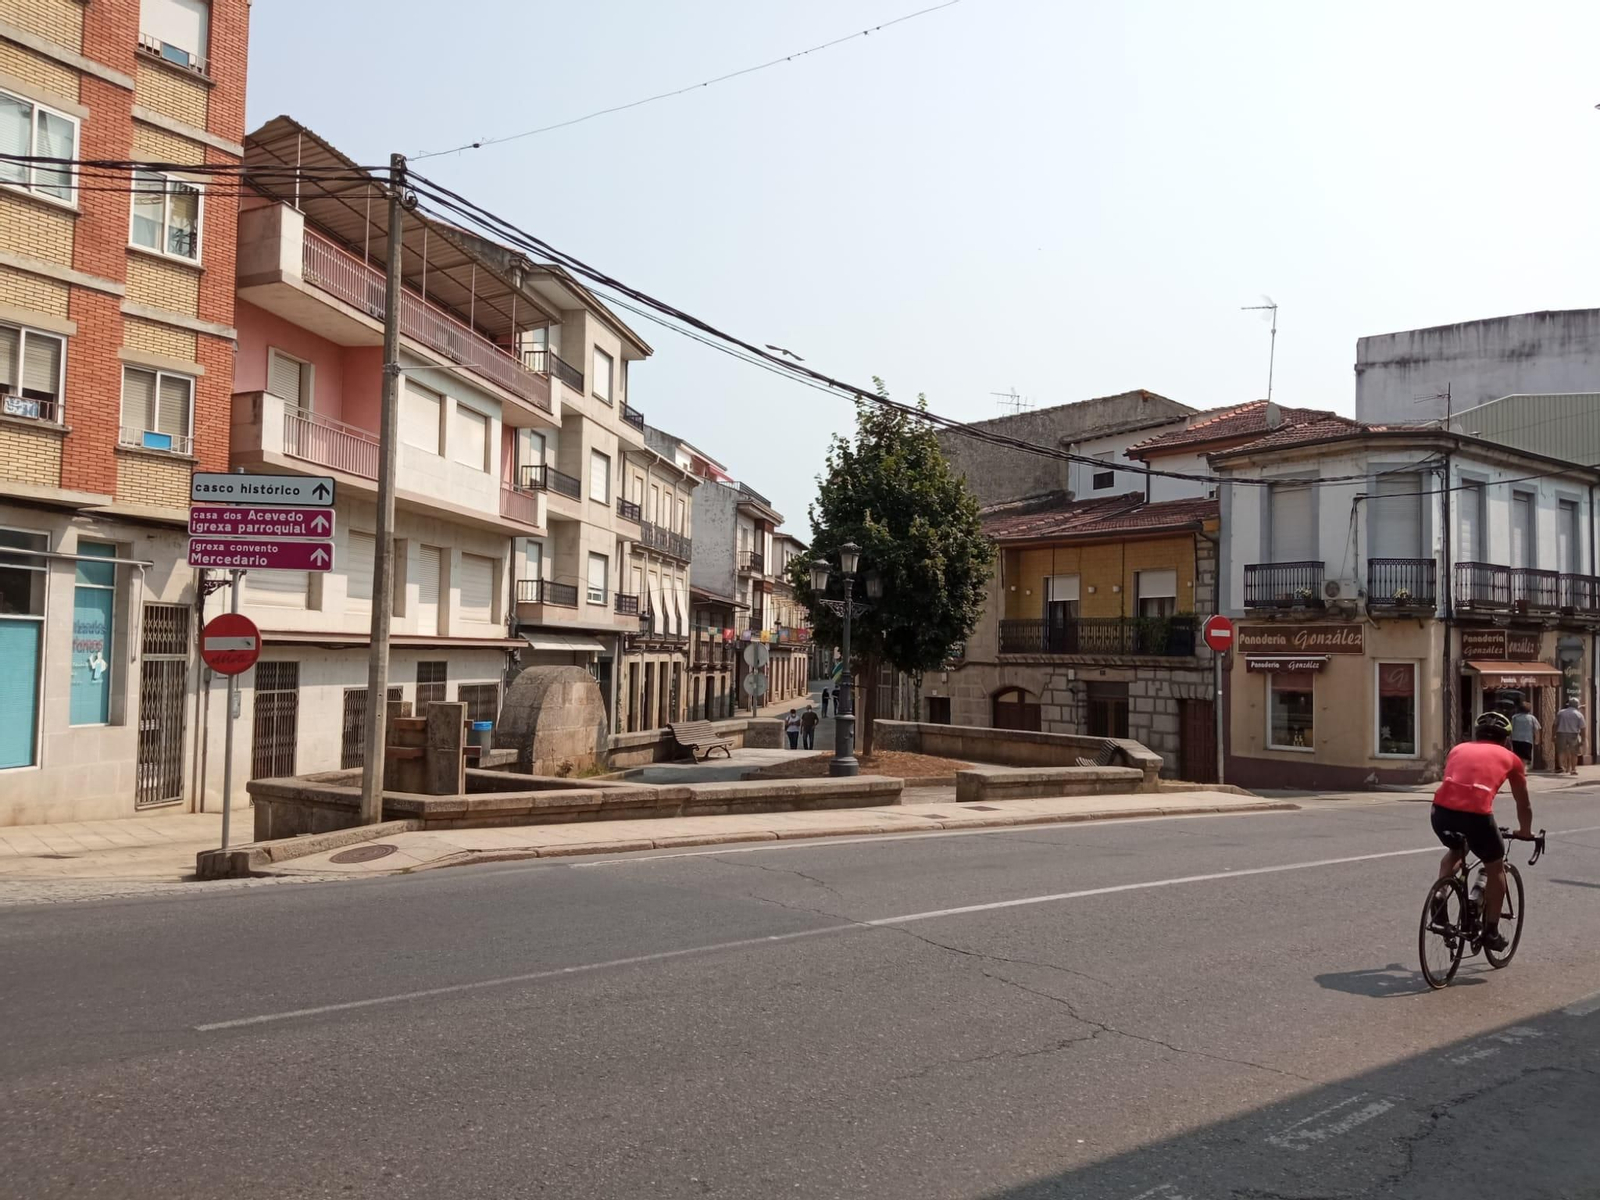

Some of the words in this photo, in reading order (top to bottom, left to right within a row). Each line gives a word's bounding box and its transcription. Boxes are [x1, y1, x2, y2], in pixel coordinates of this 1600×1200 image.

[195, 483, 234, 493] casco
[240, 483, 300, 496] histórico
[193, 511, 218, 520] casa
[223, 511, 242, 520] dos
[247, 510, 304, 522] Acevedo
[192, 521, 232, 533] igrexa
[238, 522, 306, 535] parroquial
[192, 541, 225, 552] igrexa
[230, 543, 279, 554] convento
[191, 554, 268, 566] Mercedario
[1239, 633, 1287, 645] Panadería
[1293, 628, 1362, 650] González
[1463, 645, 1504, 656] González
